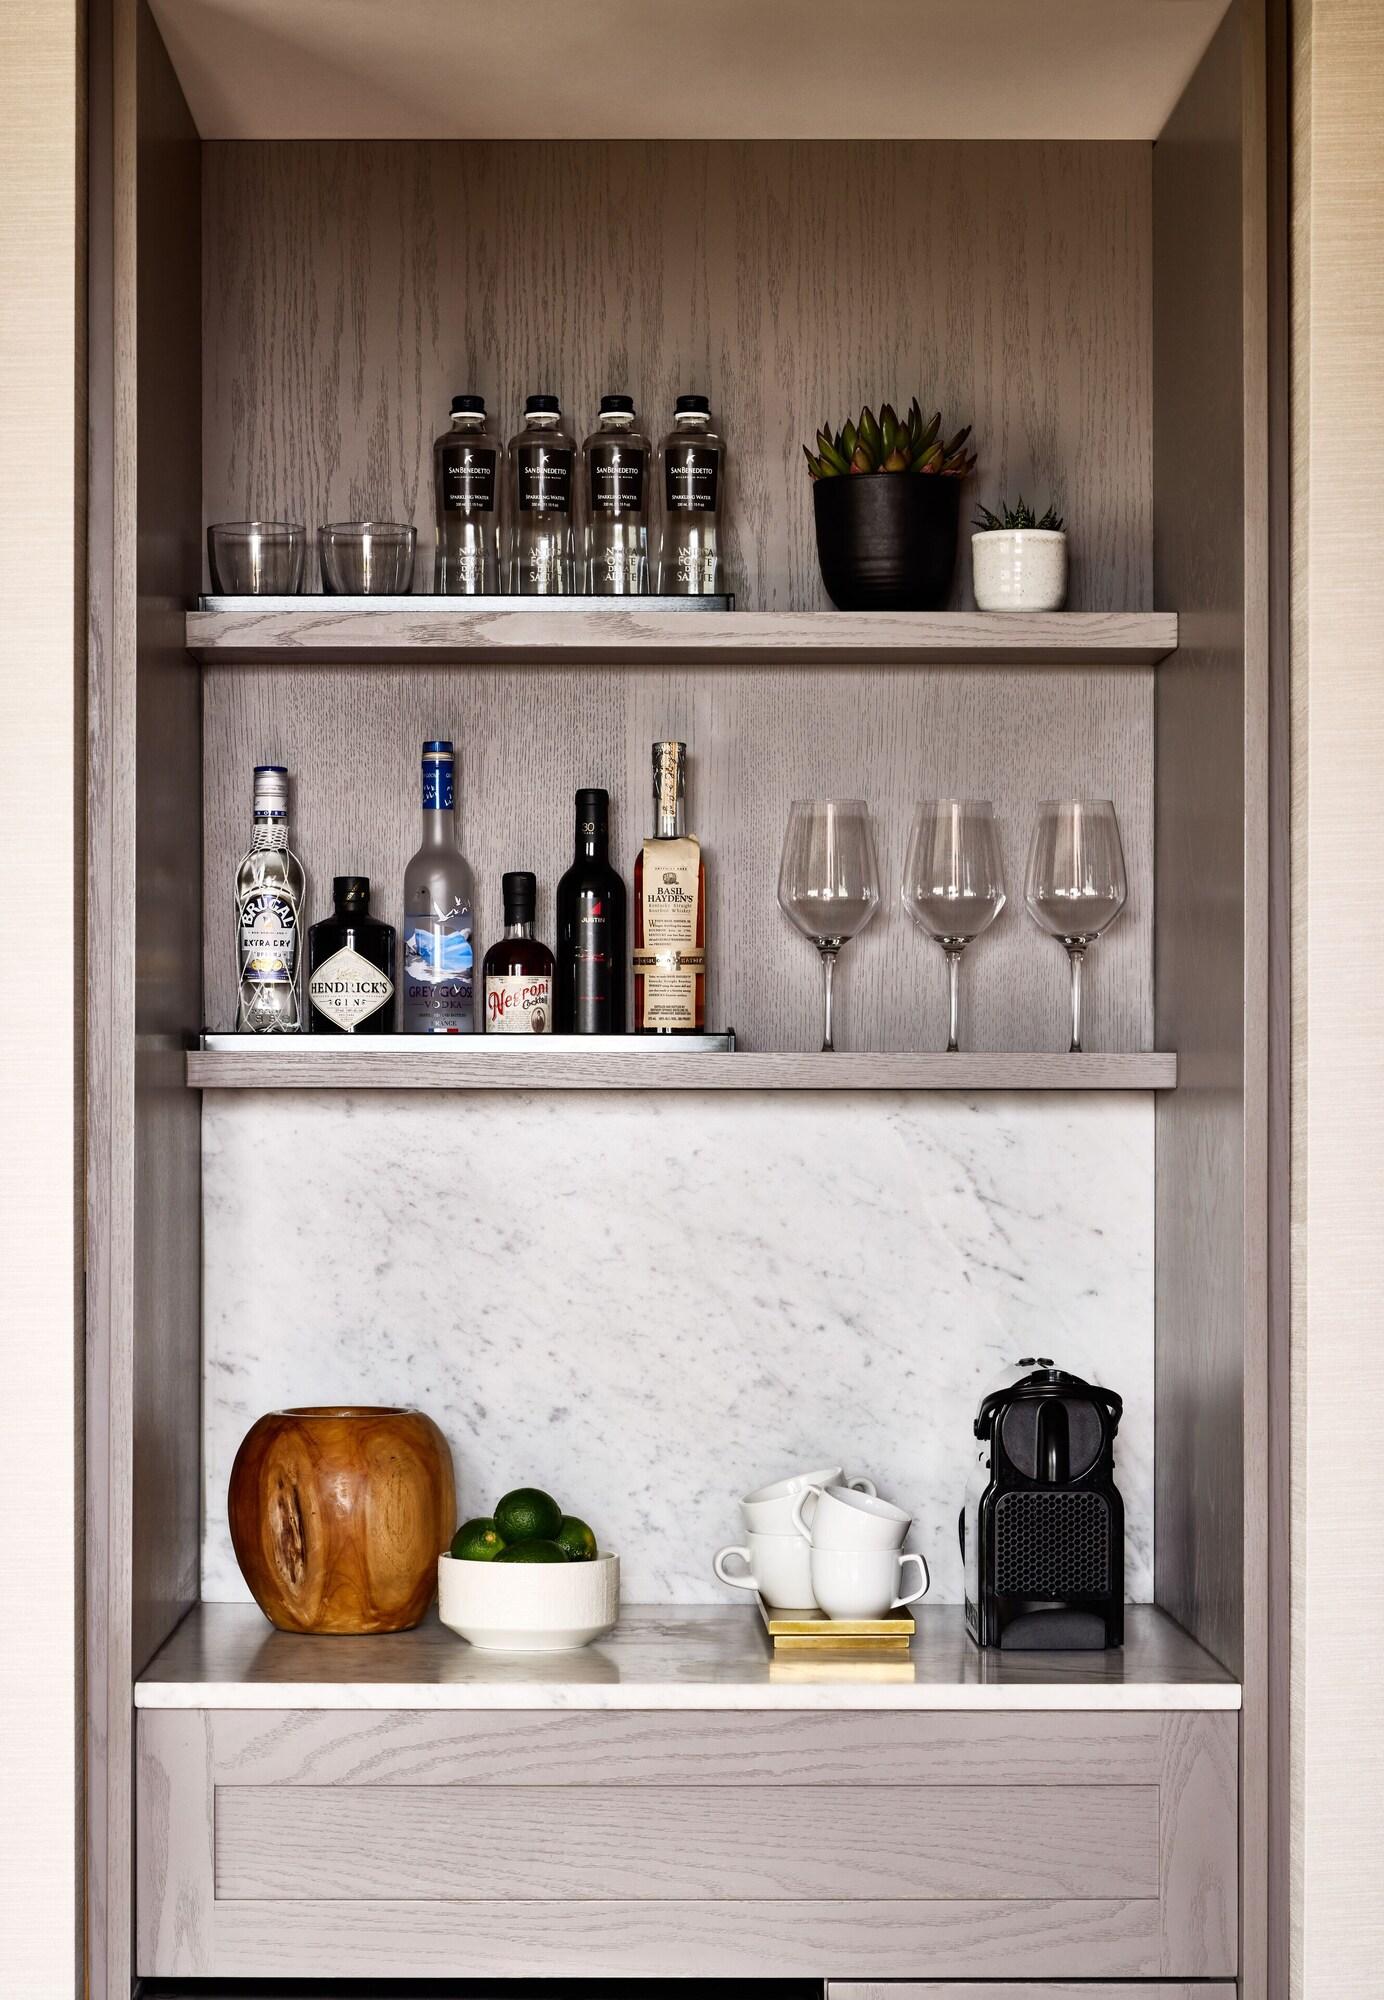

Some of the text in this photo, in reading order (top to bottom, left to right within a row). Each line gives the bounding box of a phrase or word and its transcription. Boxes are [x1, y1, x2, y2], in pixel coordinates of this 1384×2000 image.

[581, 822, 595, 832] 30
[657, 887, 685, 895] BASIL
[647, 894, 694, 903] HAYDEN'S
[241, 897, 294, 928] BRUGAL
[244, 939, 291, 947] EXTRA DRY
[408, 985, 435, 998] GREY
[424, 1000, 462, 1009] VODKA
